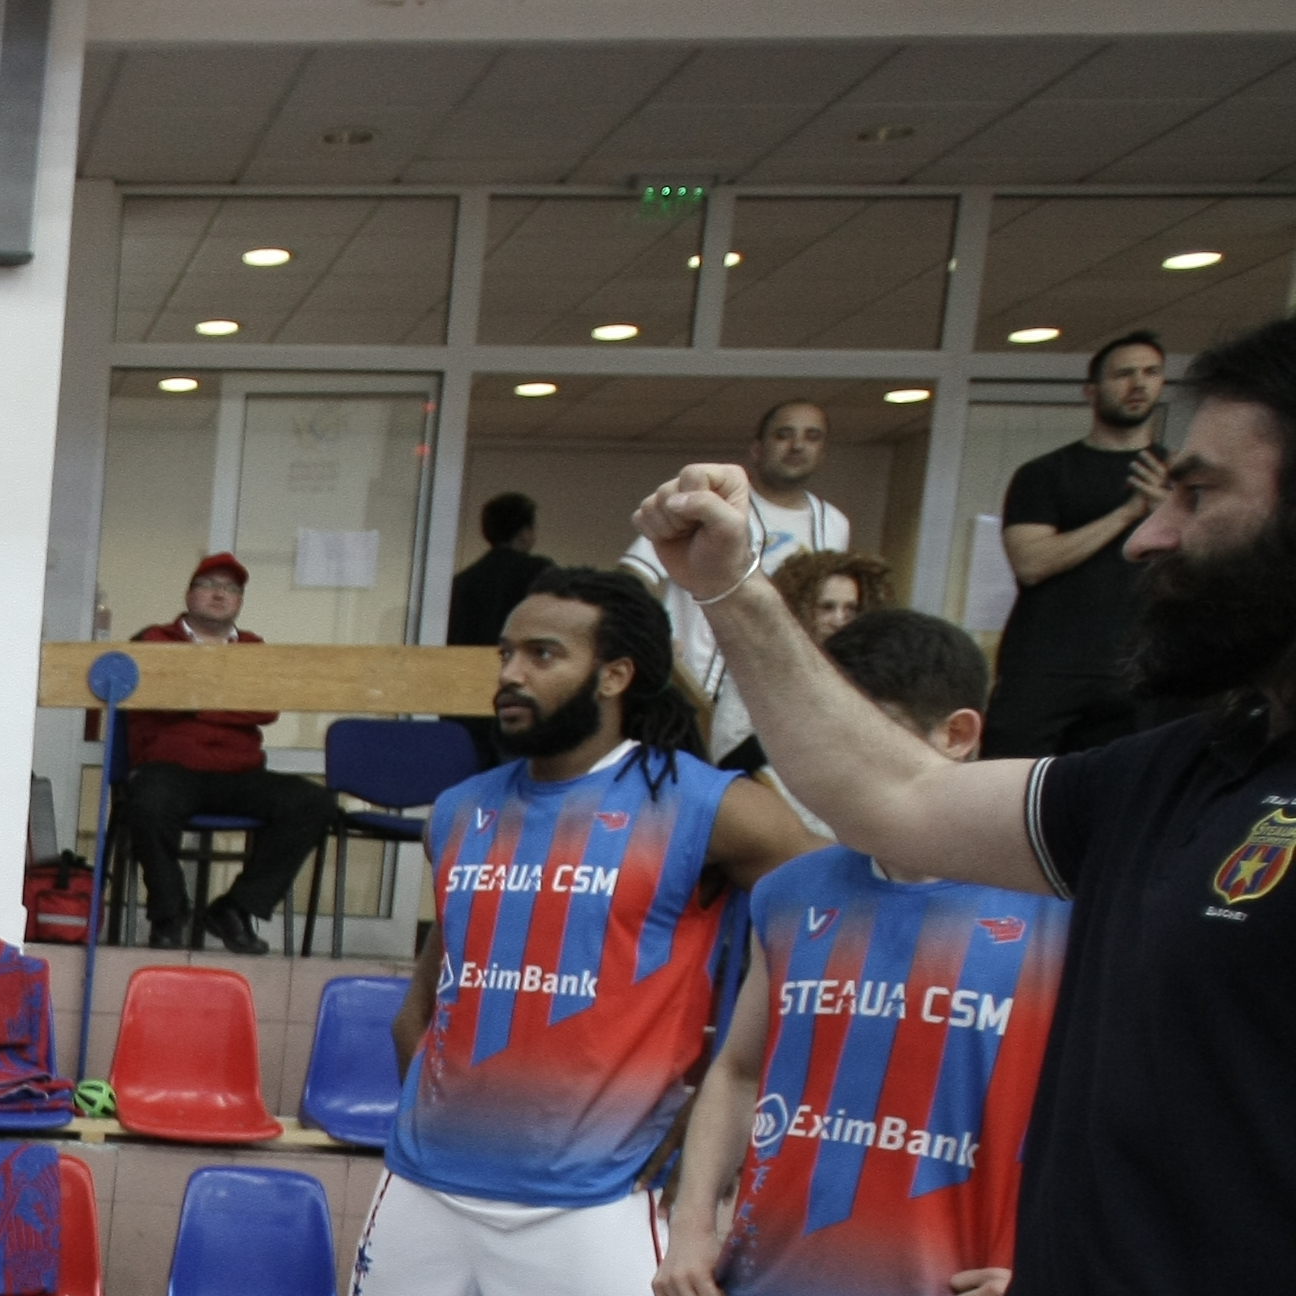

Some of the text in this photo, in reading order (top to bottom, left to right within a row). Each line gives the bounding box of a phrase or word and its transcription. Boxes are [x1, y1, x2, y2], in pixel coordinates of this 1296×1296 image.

[446, 864, 620, 897] STEAUA CSM
[459, 961, 598, 998] EximBank
[779, 979, 1014, 1036] STEAUA CSM
[787, 1105, 980, 1169] EximBank
